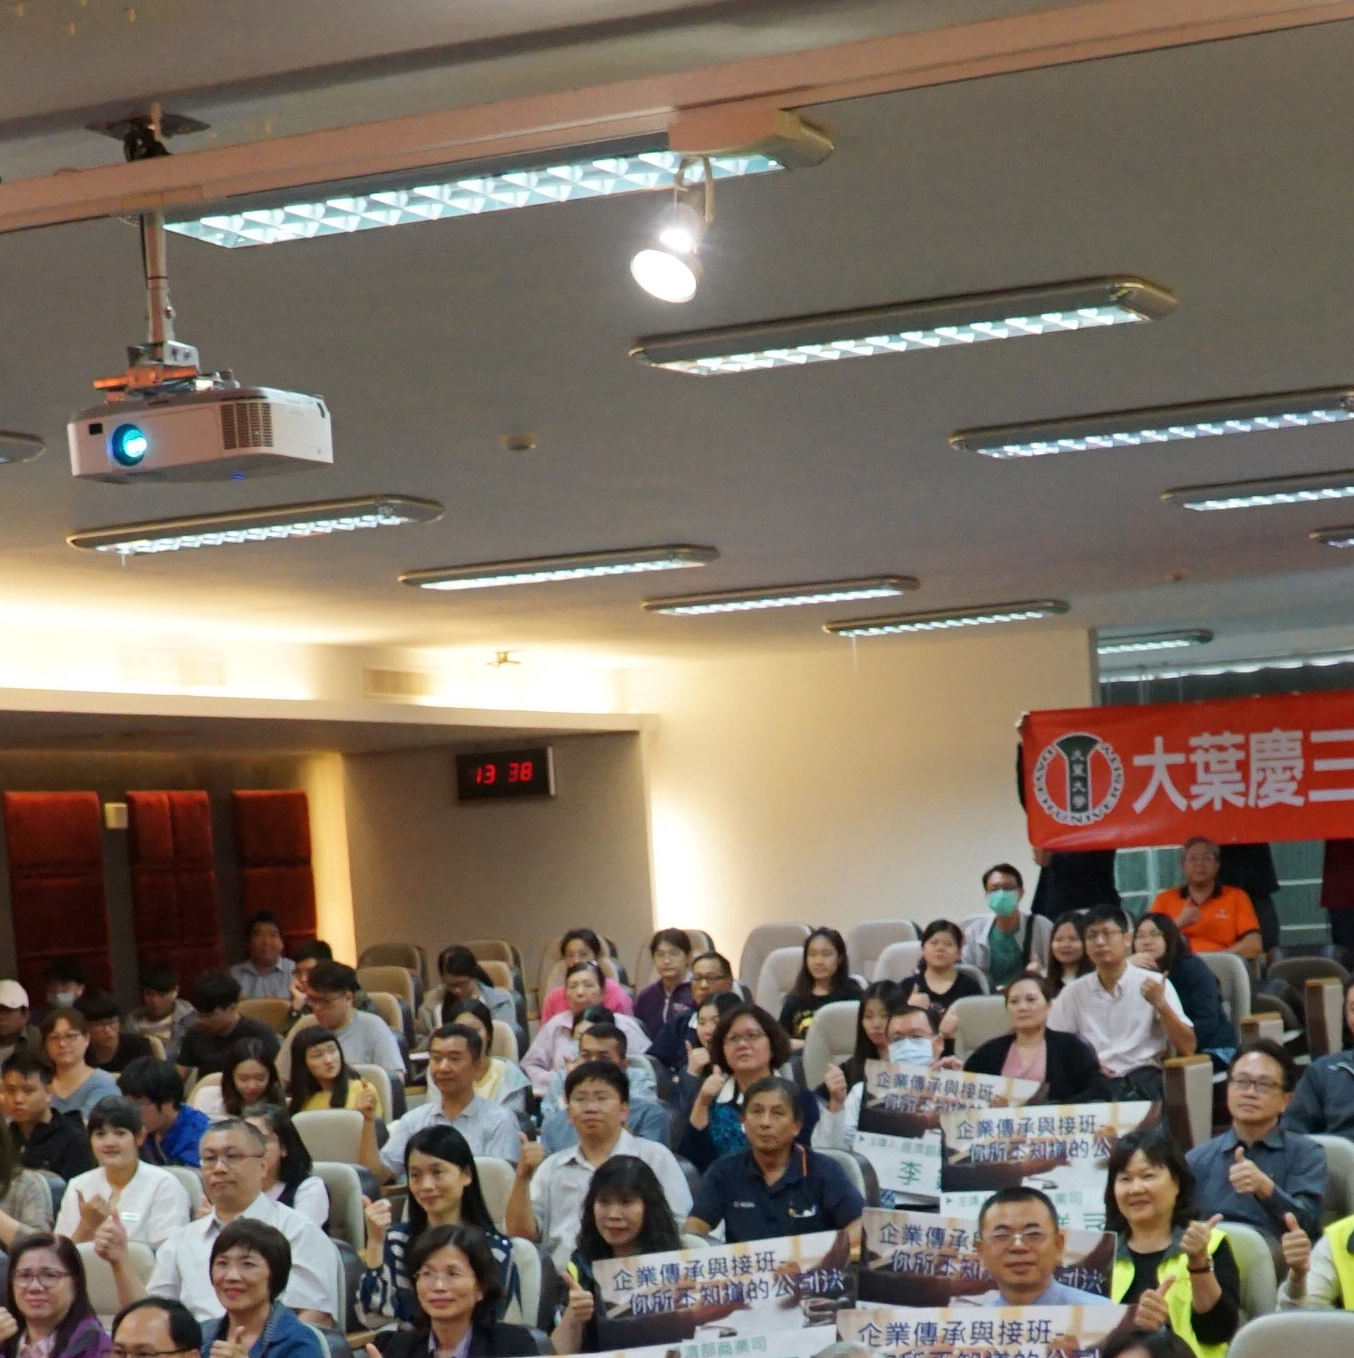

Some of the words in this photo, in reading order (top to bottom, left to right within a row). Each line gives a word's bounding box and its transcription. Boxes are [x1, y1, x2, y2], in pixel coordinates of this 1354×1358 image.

[476, 764, 496, 785] 13
[508, 761, 533, 782] 38
[897, 1161, 923, 1187] 李
[612, 1251, 787, 1292] 企業傳承與接班-
[629, 1268, 845, 1315] 你所不知道的公司法
[858, 1319, 1068, 1347] 企業傳承與接班-
